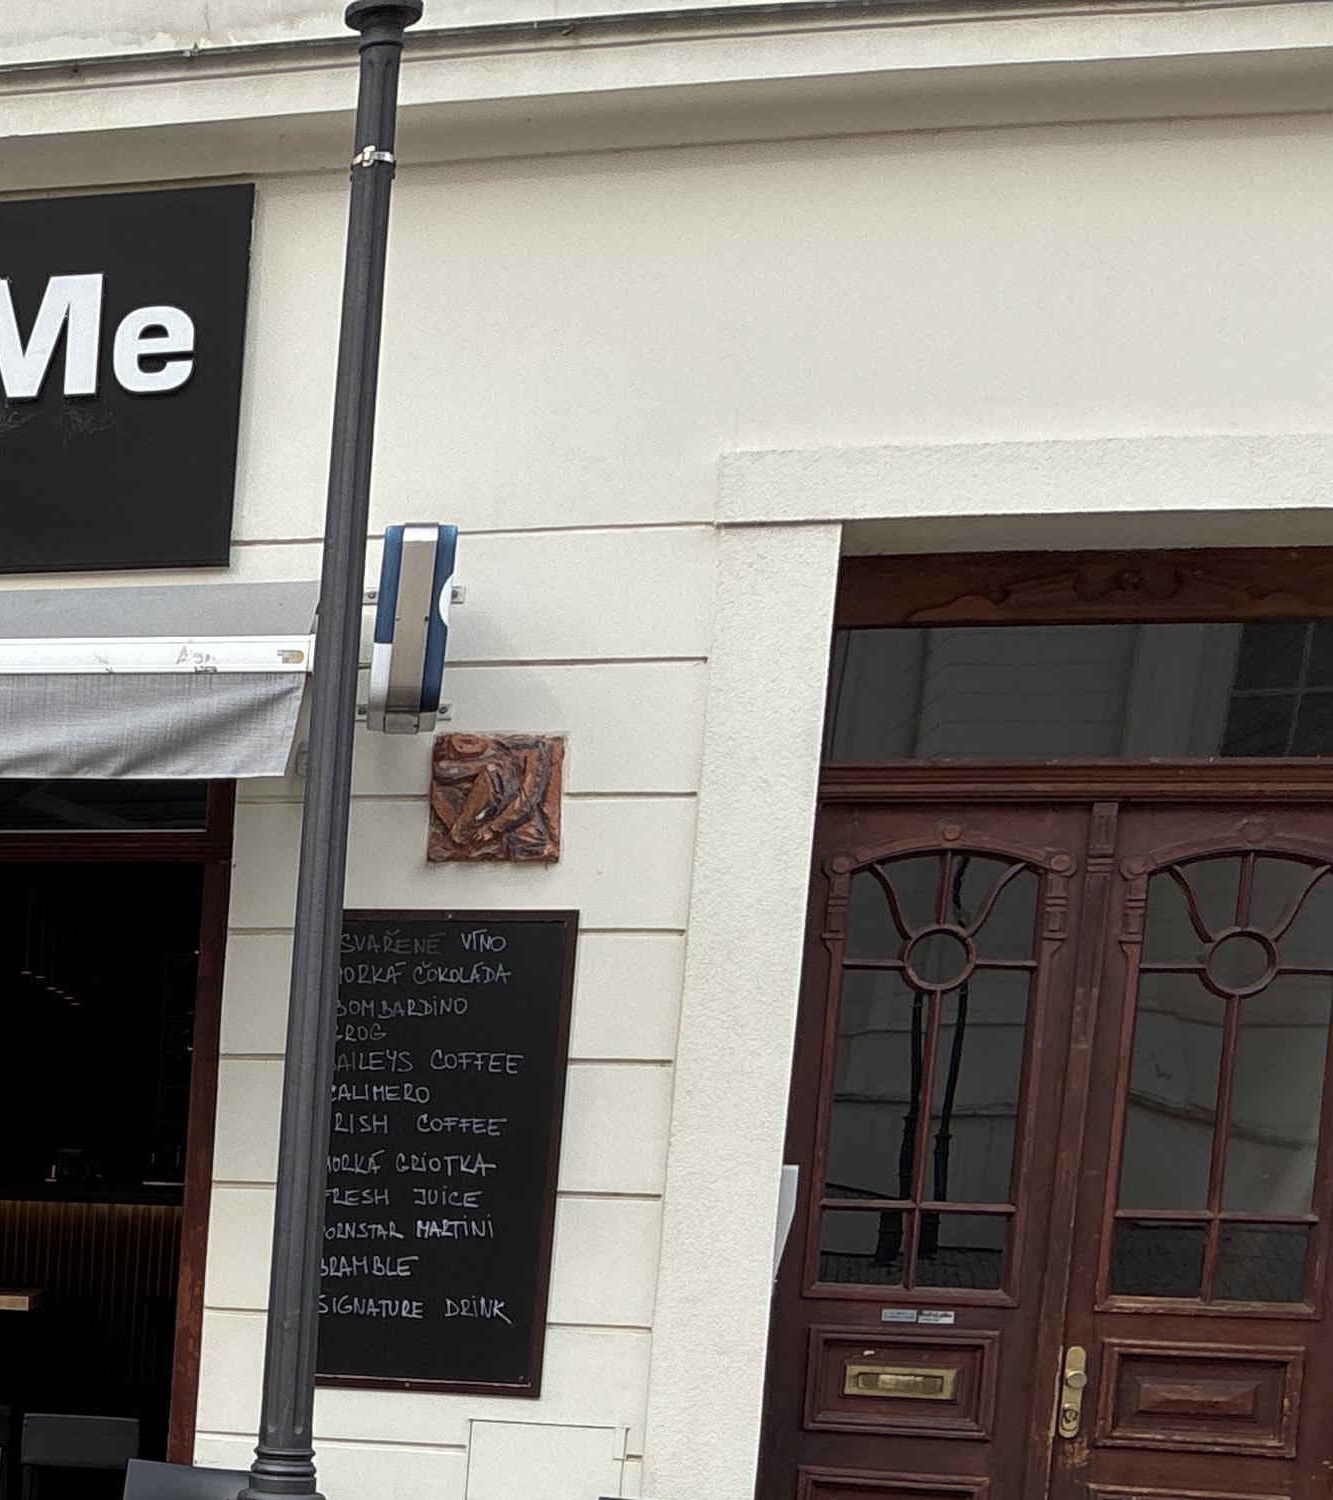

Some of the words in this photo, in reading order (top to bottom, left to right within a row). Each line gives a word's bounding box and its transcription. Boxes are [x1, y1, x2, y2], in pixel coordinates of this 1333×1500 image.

[461, 929, 507, 952] VÍNO
[339, 962, 407, 985] ORKÁ
[413, 961, 512, 985] ČOKOLÁDA
[333, 1050, 414, 1073] AILEYS
[430, 1050, 525, 1075] COFFEE
[417, 1113, 508, 1136] COFFEE
[323, 1220, 405, 1240] ORNSTAR
[416, 1213, 495, 1240] MARTINI
[445, 1295, 513, 1325] DRINK
